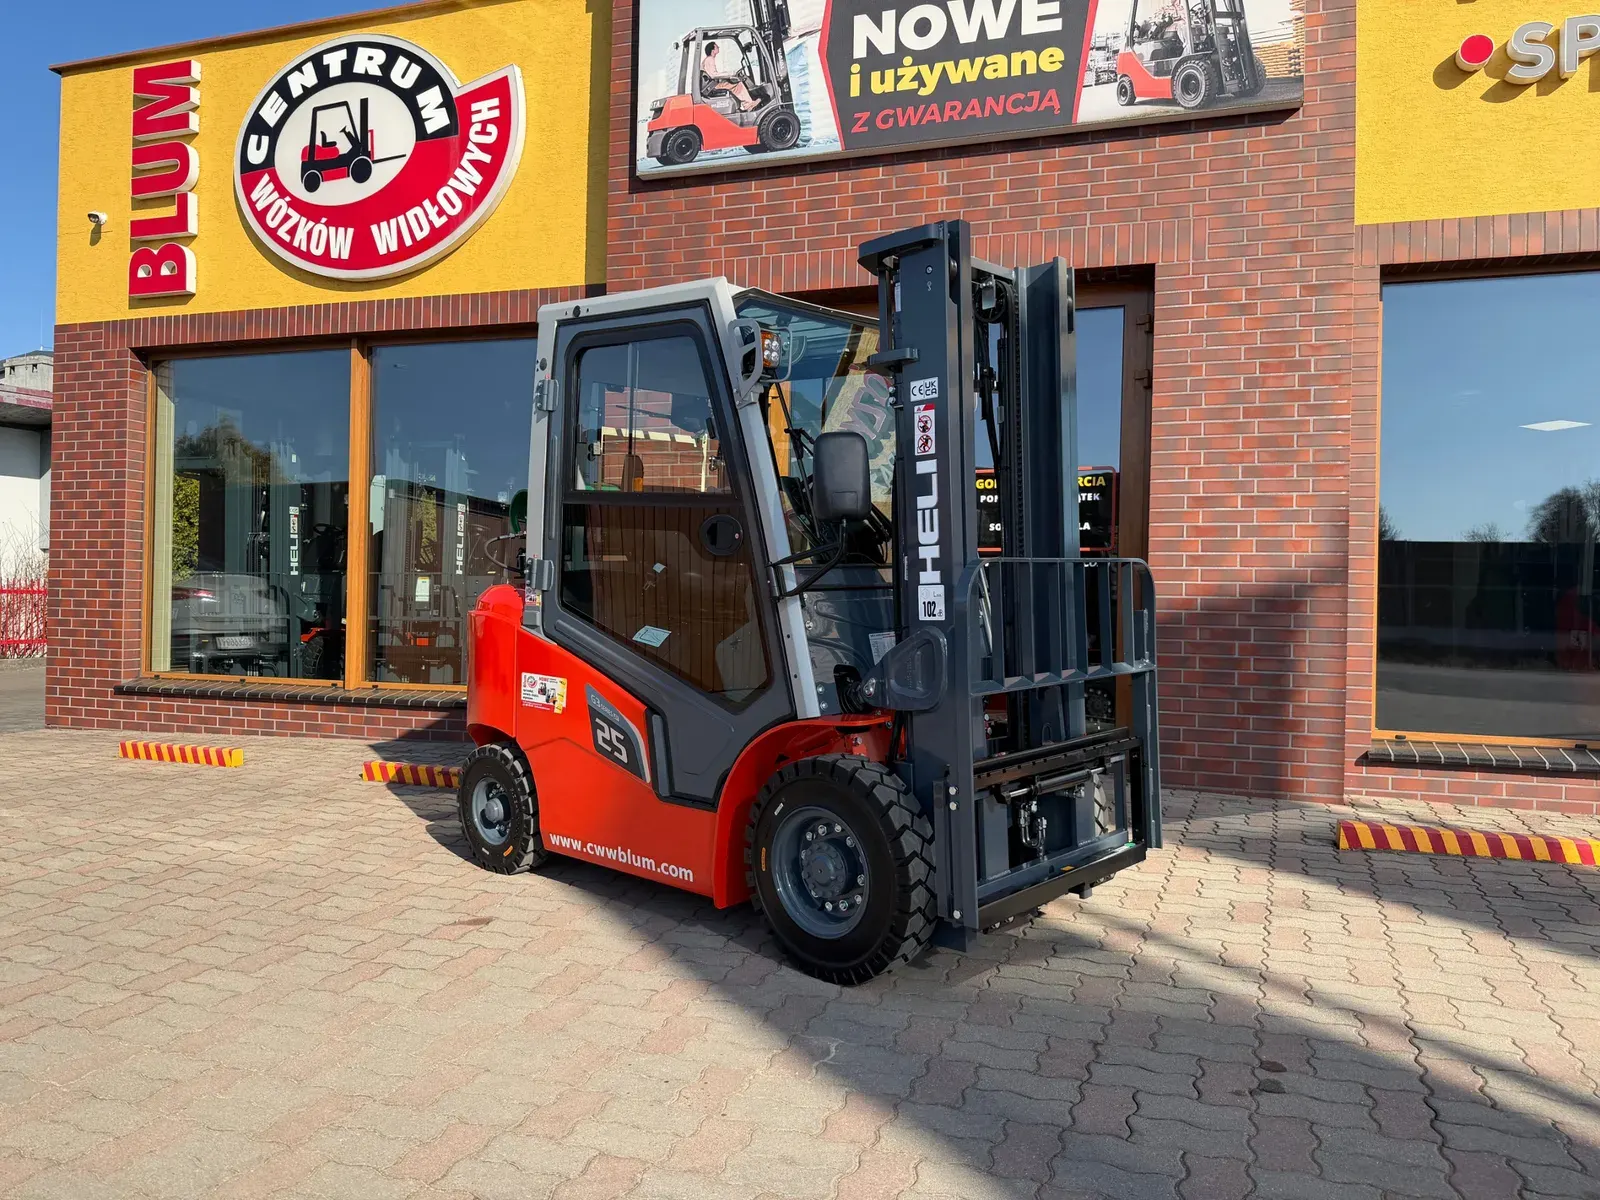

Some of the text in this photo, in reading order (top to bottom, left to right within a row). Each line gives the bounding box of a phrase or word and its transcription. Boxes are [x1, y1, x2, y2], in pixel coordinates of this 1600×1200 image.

[853, 0, 1063, 59] NOWE
[850, 47, 1065, 97] i używane
[248, 47, 451, 164] CENTRUM
[851, 88, 1061, 133] Z GWARANCJĄ
[129, 60, 197, 297] BLUM
[250, 97, 500, 260] WÓZKÓW WIDŁOWYCH
[916, 459, 941, 584] HELI
[290, 534, 298, 575] HELI
[456, 532, 464, 575] HELI
[923, 600, 937, 617] 102
[595, 717, 628, 764] 25
[549, 833, 694, 882] www.cwwblum.com
